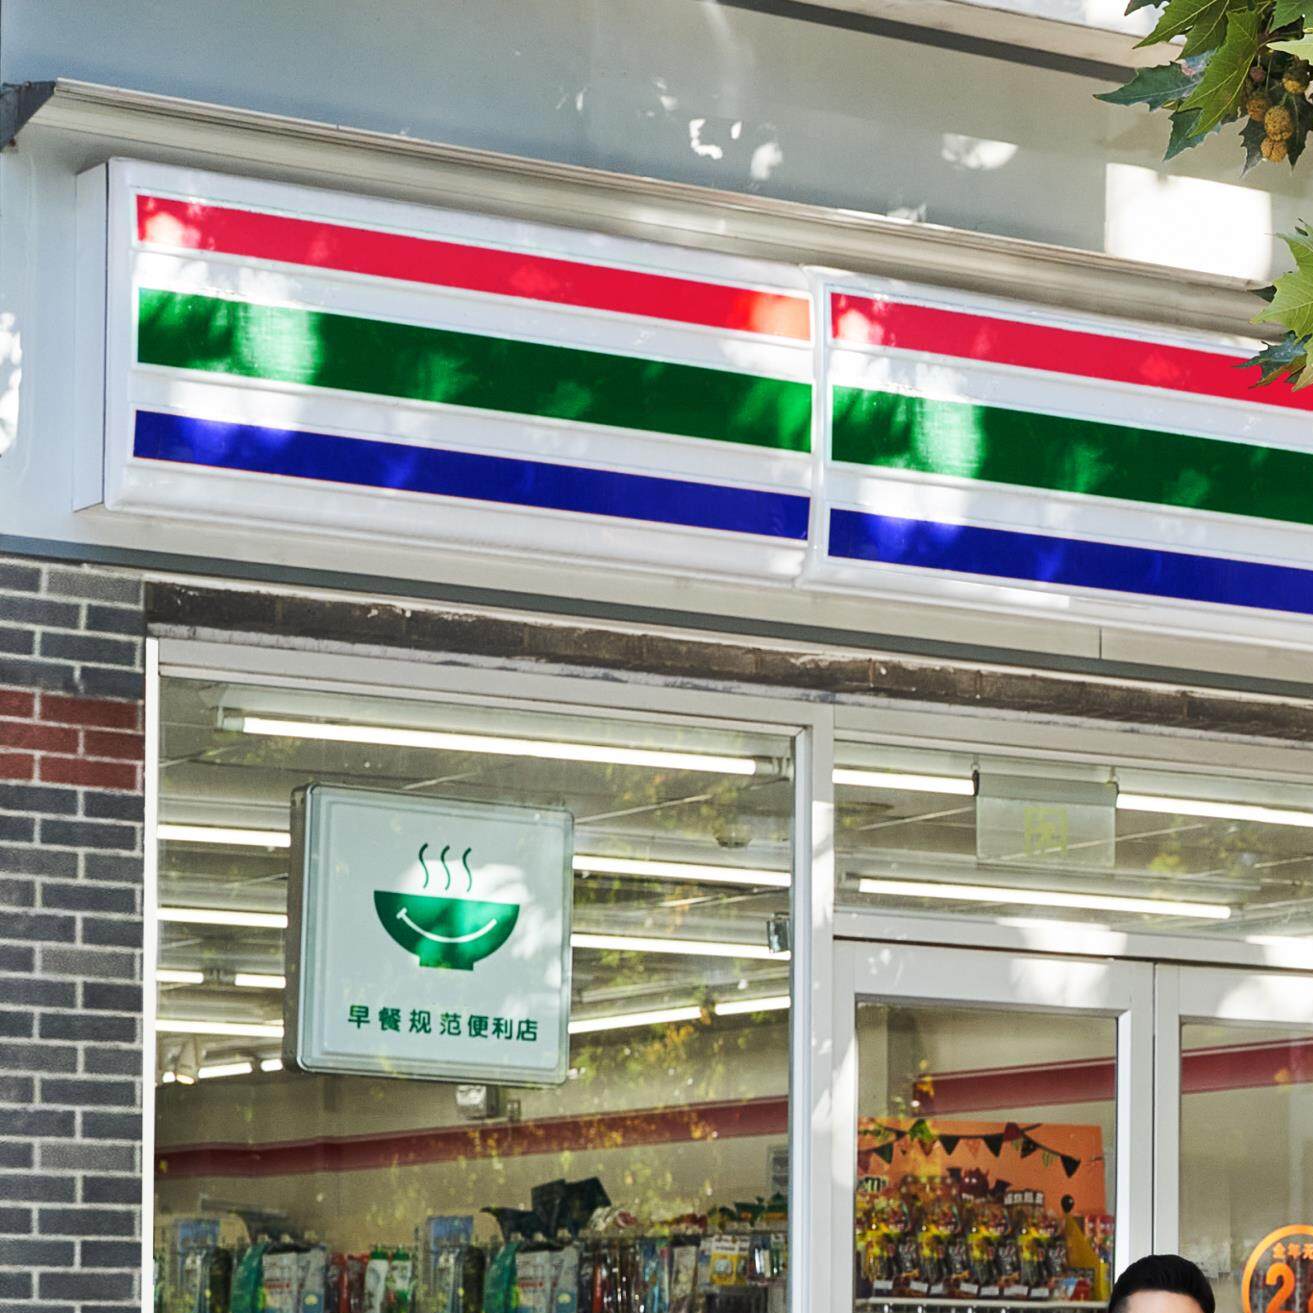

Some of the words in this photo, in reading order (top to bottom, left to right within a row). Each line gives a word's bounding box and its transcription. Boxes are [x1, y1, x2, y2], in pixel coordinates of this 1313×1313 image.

[348, 1004, 539, 1042] 早餐规范便利店
